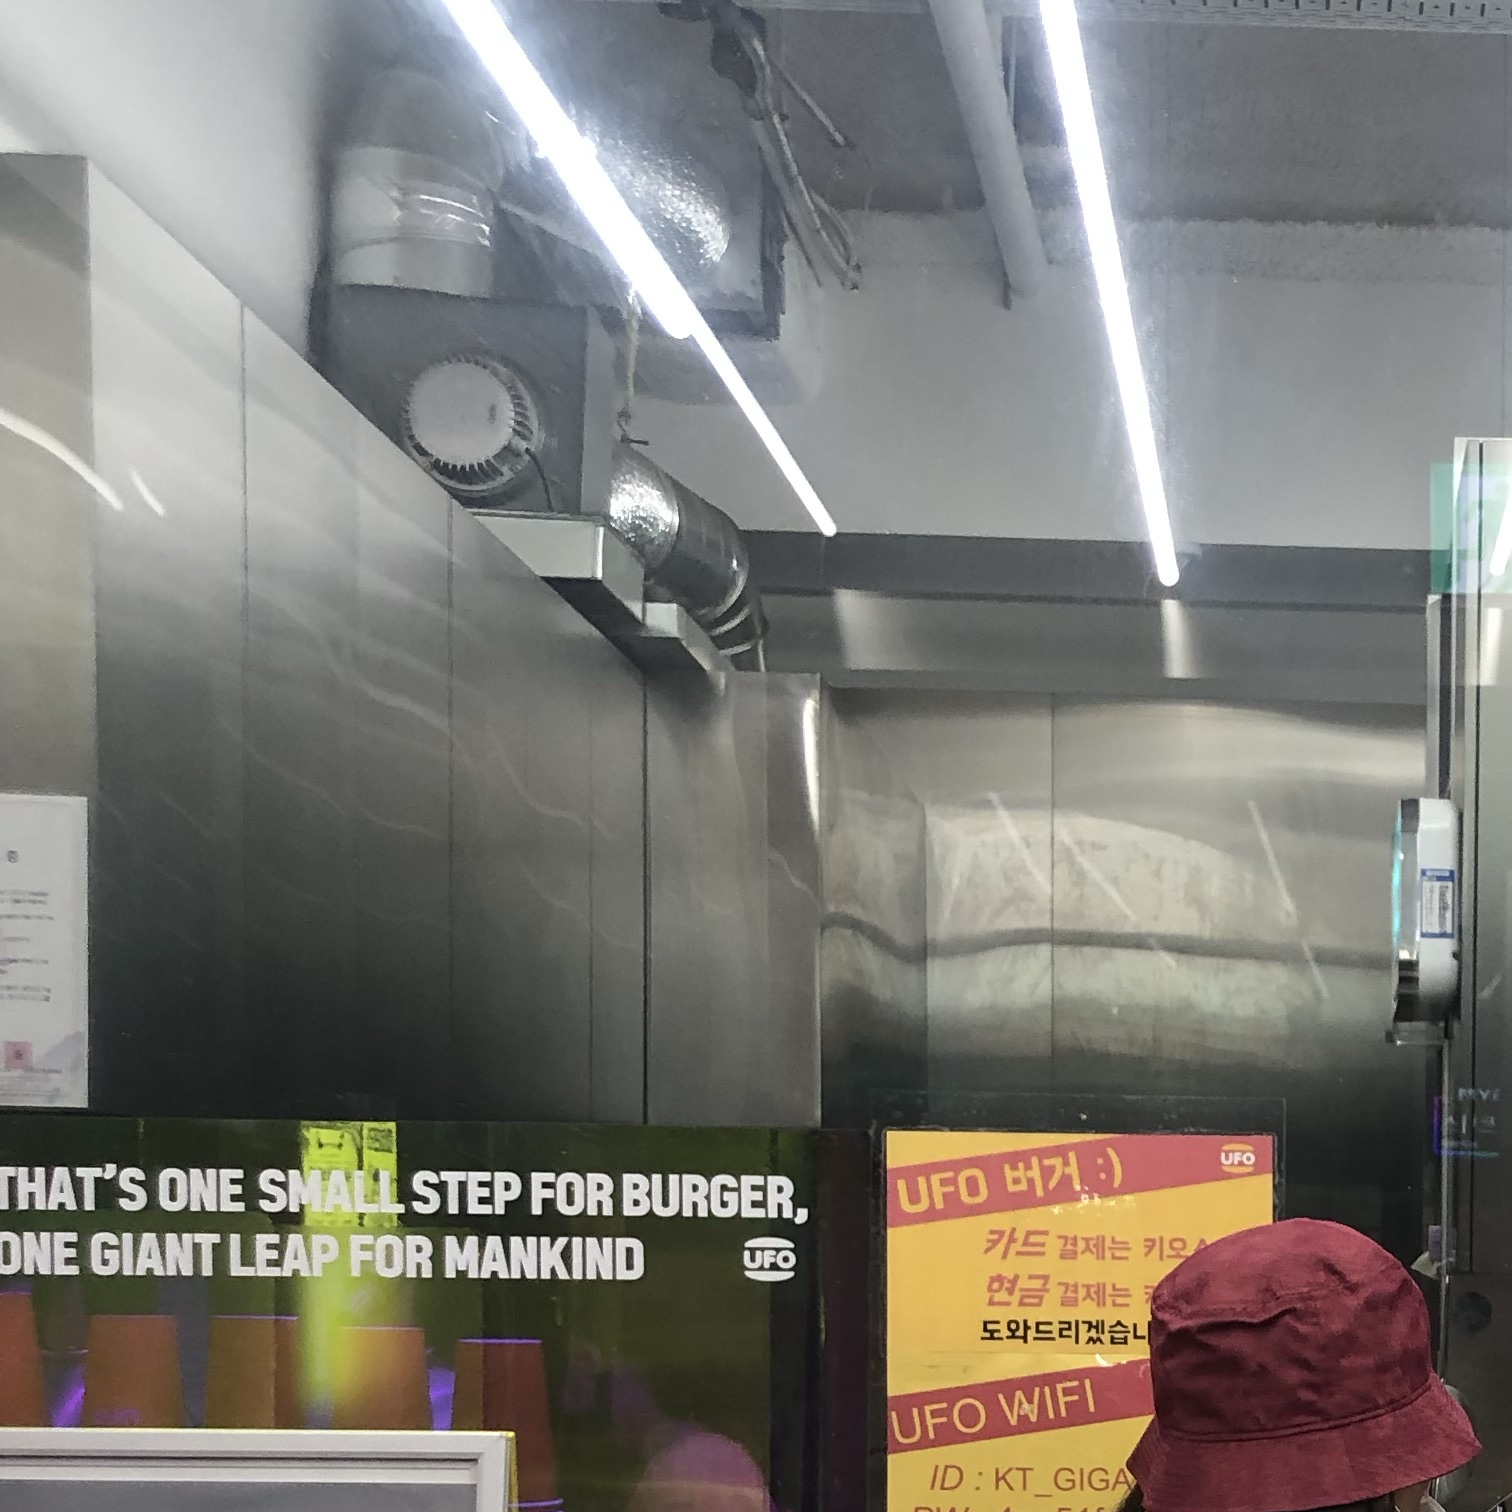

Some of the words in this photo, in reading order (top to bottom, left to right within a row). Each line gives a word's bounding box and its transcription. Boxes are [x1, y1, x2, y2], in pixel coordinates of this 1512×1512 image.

[1220, 1151, 1255, 1165] UFO
[0, 1163, 147, 1212] THAT'S
[159, 1168, 245, 1213] ONE
[258, 1169, 405, 1214] SMALL
[412, 1170, 521, 1215] STEP
[531, 1171, 614, 1216] FOR
[622, 1174, 809, 1226] BURGER,
[897, 1167, 988, 1214] UFO
[1004, 1151, 1081, 1197] 버거
[0, 1231, 80, 1276] ONE
[91, 1231, 220, 1277] GIANT
[230, 1234, 340, 1279] LEAP
[350, 1234, 432, 1280] FOR
[445, 1236, 645, 1281] MANKIND
[743, 1249, 796, 1270] UFO
[983, 1227, 1049, 1260] 카드
[1057, 1234, 1132, 1261] 결제는
[986, 1274, 1050, 1308] 현금
[1057, 1280, 1132, 1308] 결제는
[890, 1397, 986, 1444] UFO
[997, 1378, 1096, 1427] WIFI
[930, 1464, 964, 1491] ID
[994, 1467, 1133, 1497] KT_GIGA
